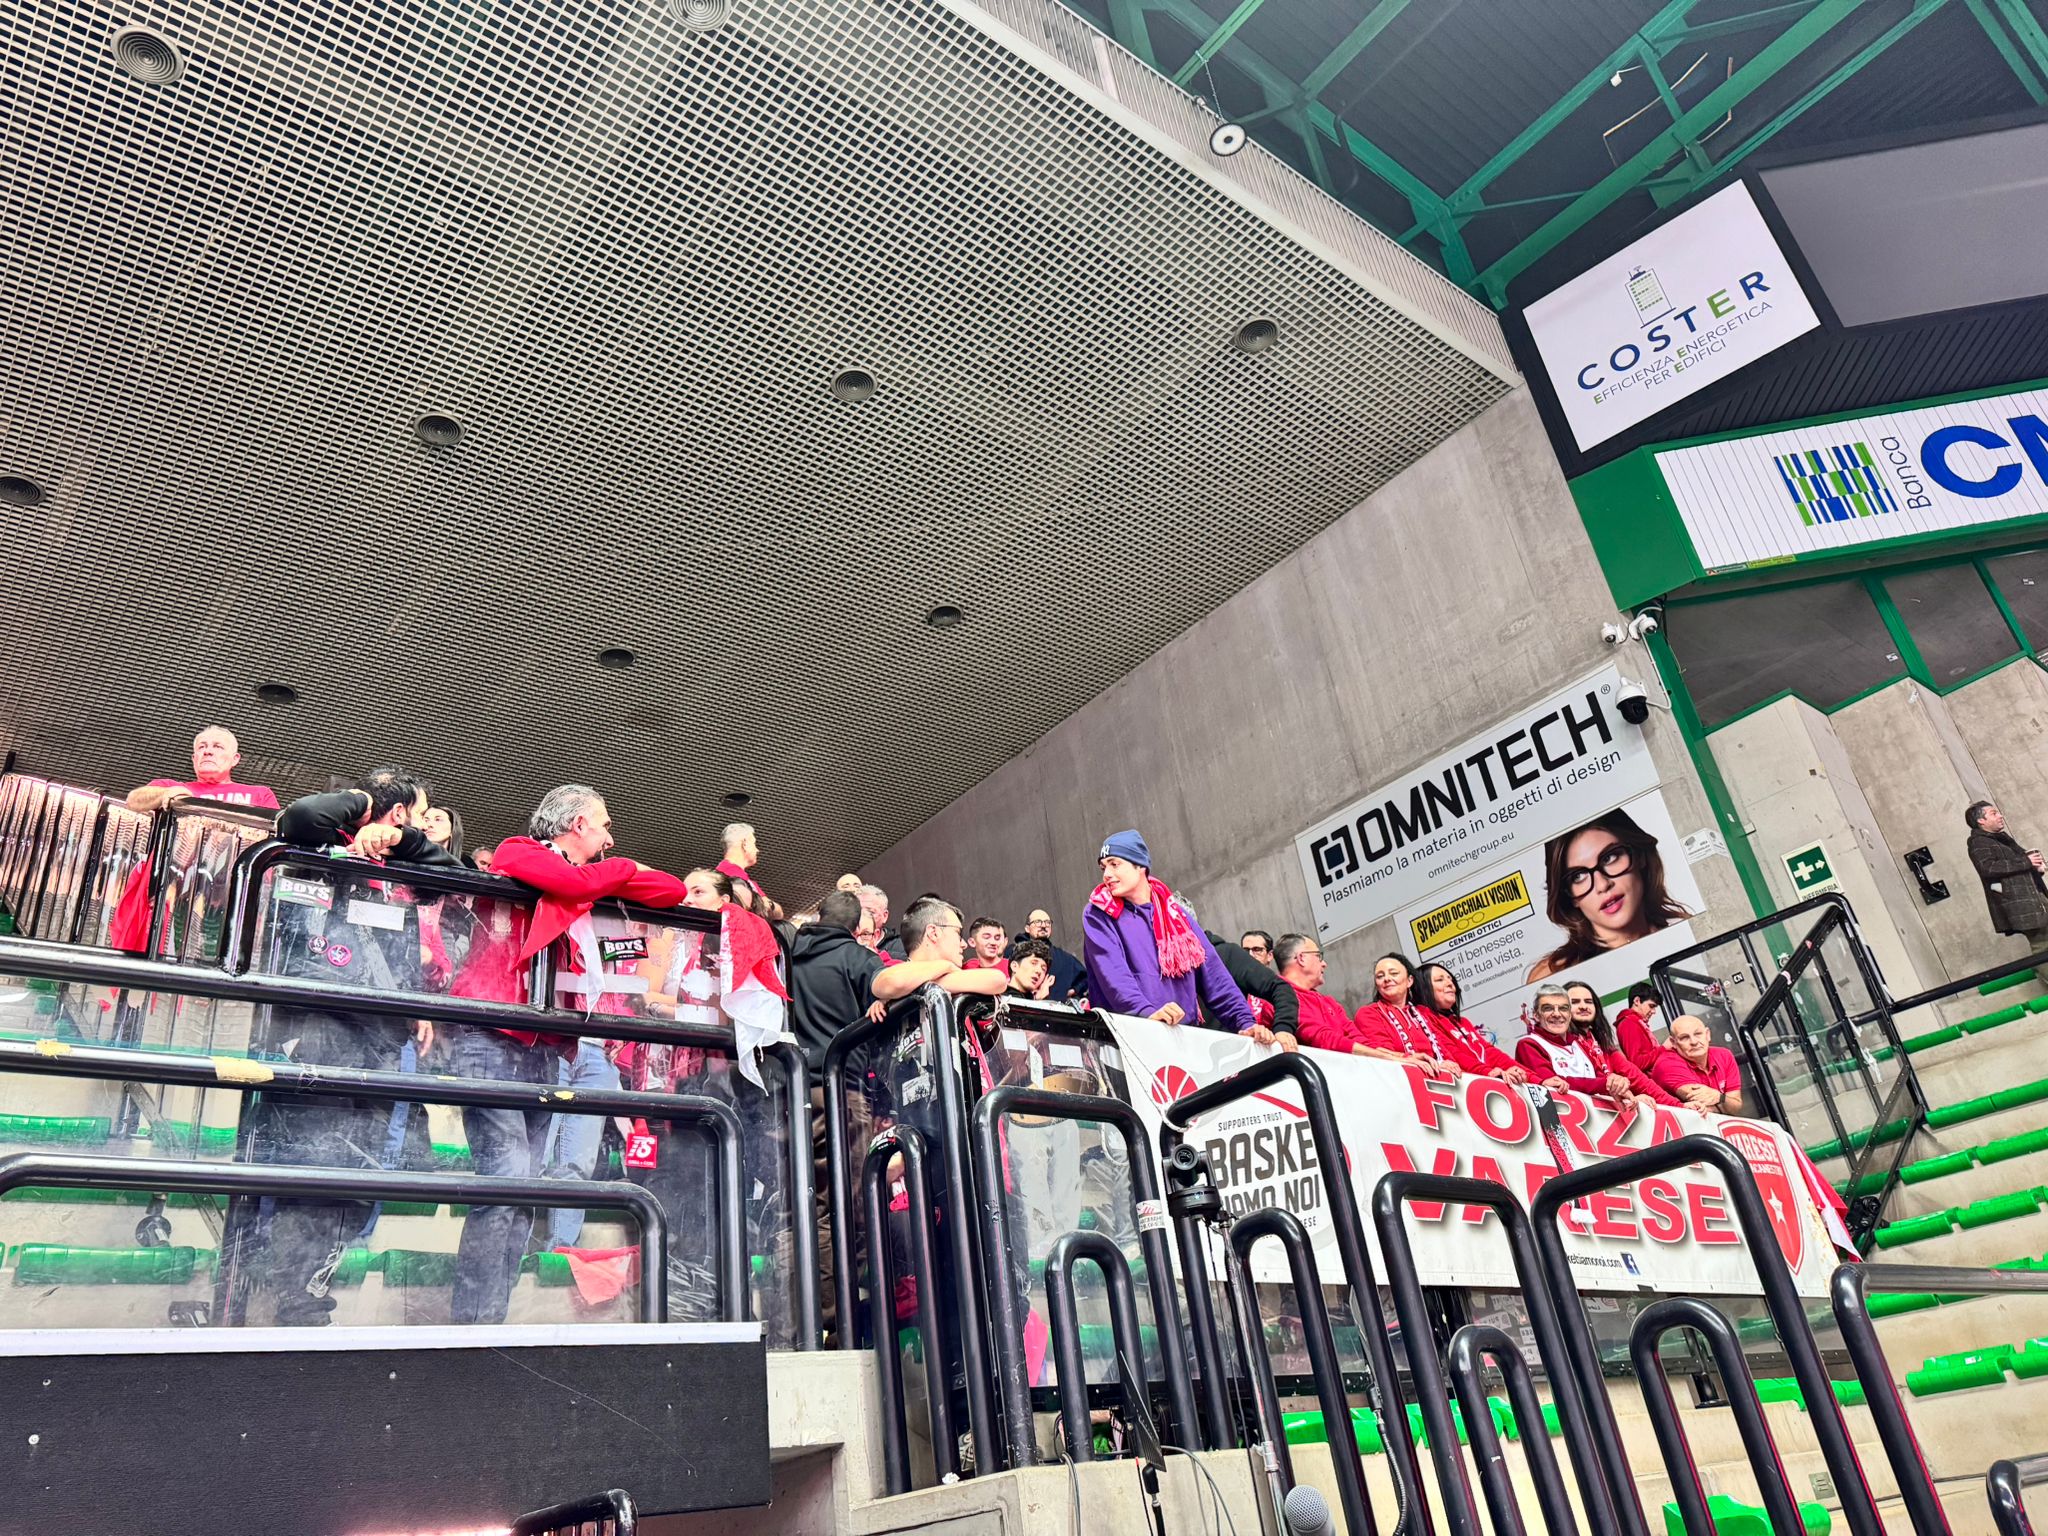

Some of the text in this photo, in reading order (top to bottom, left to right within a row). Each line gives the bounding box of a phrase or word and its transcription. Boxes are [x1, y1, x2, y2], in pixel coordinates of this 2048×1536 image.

[1578, 271, 1771, 390] COSTER
[1593, 301, 1773, 404] EFFICIENZA ENERGETICA
[1644, 339, 1727, 390] PER EDIFICI
[1880, 436, 1932, 510] Banca
[1323, 751, 1621, 907] Plasmiamo la materia in oggetti di design
[1428, 831, 1515, 878] omnitechgroup.eu
[280, 880, 331, 901] BOYS
[1416, 878, 1522, 943] SPACCIO OCCHIALI VISION
[604, 939, 644, 955] BOYS
[1448, 920, 1502, 948] CENTRI OTTICI
[1457, 952, 1464, 964] il
[1465, 929, 1525, 961] benessere
[1453, 946, 1525, 982] ella tua vista.
[1218, 1111, 1283, 1132] SUPPORTERS TRUST
[1401, 1064, 1703, 1169] FORZA
[1205, 1121, 1318, 1190] BASKE
[1726, 1132, 1780, 1163] VARESE
[1220, 1173, 1321, 1218] IAMO NOI
